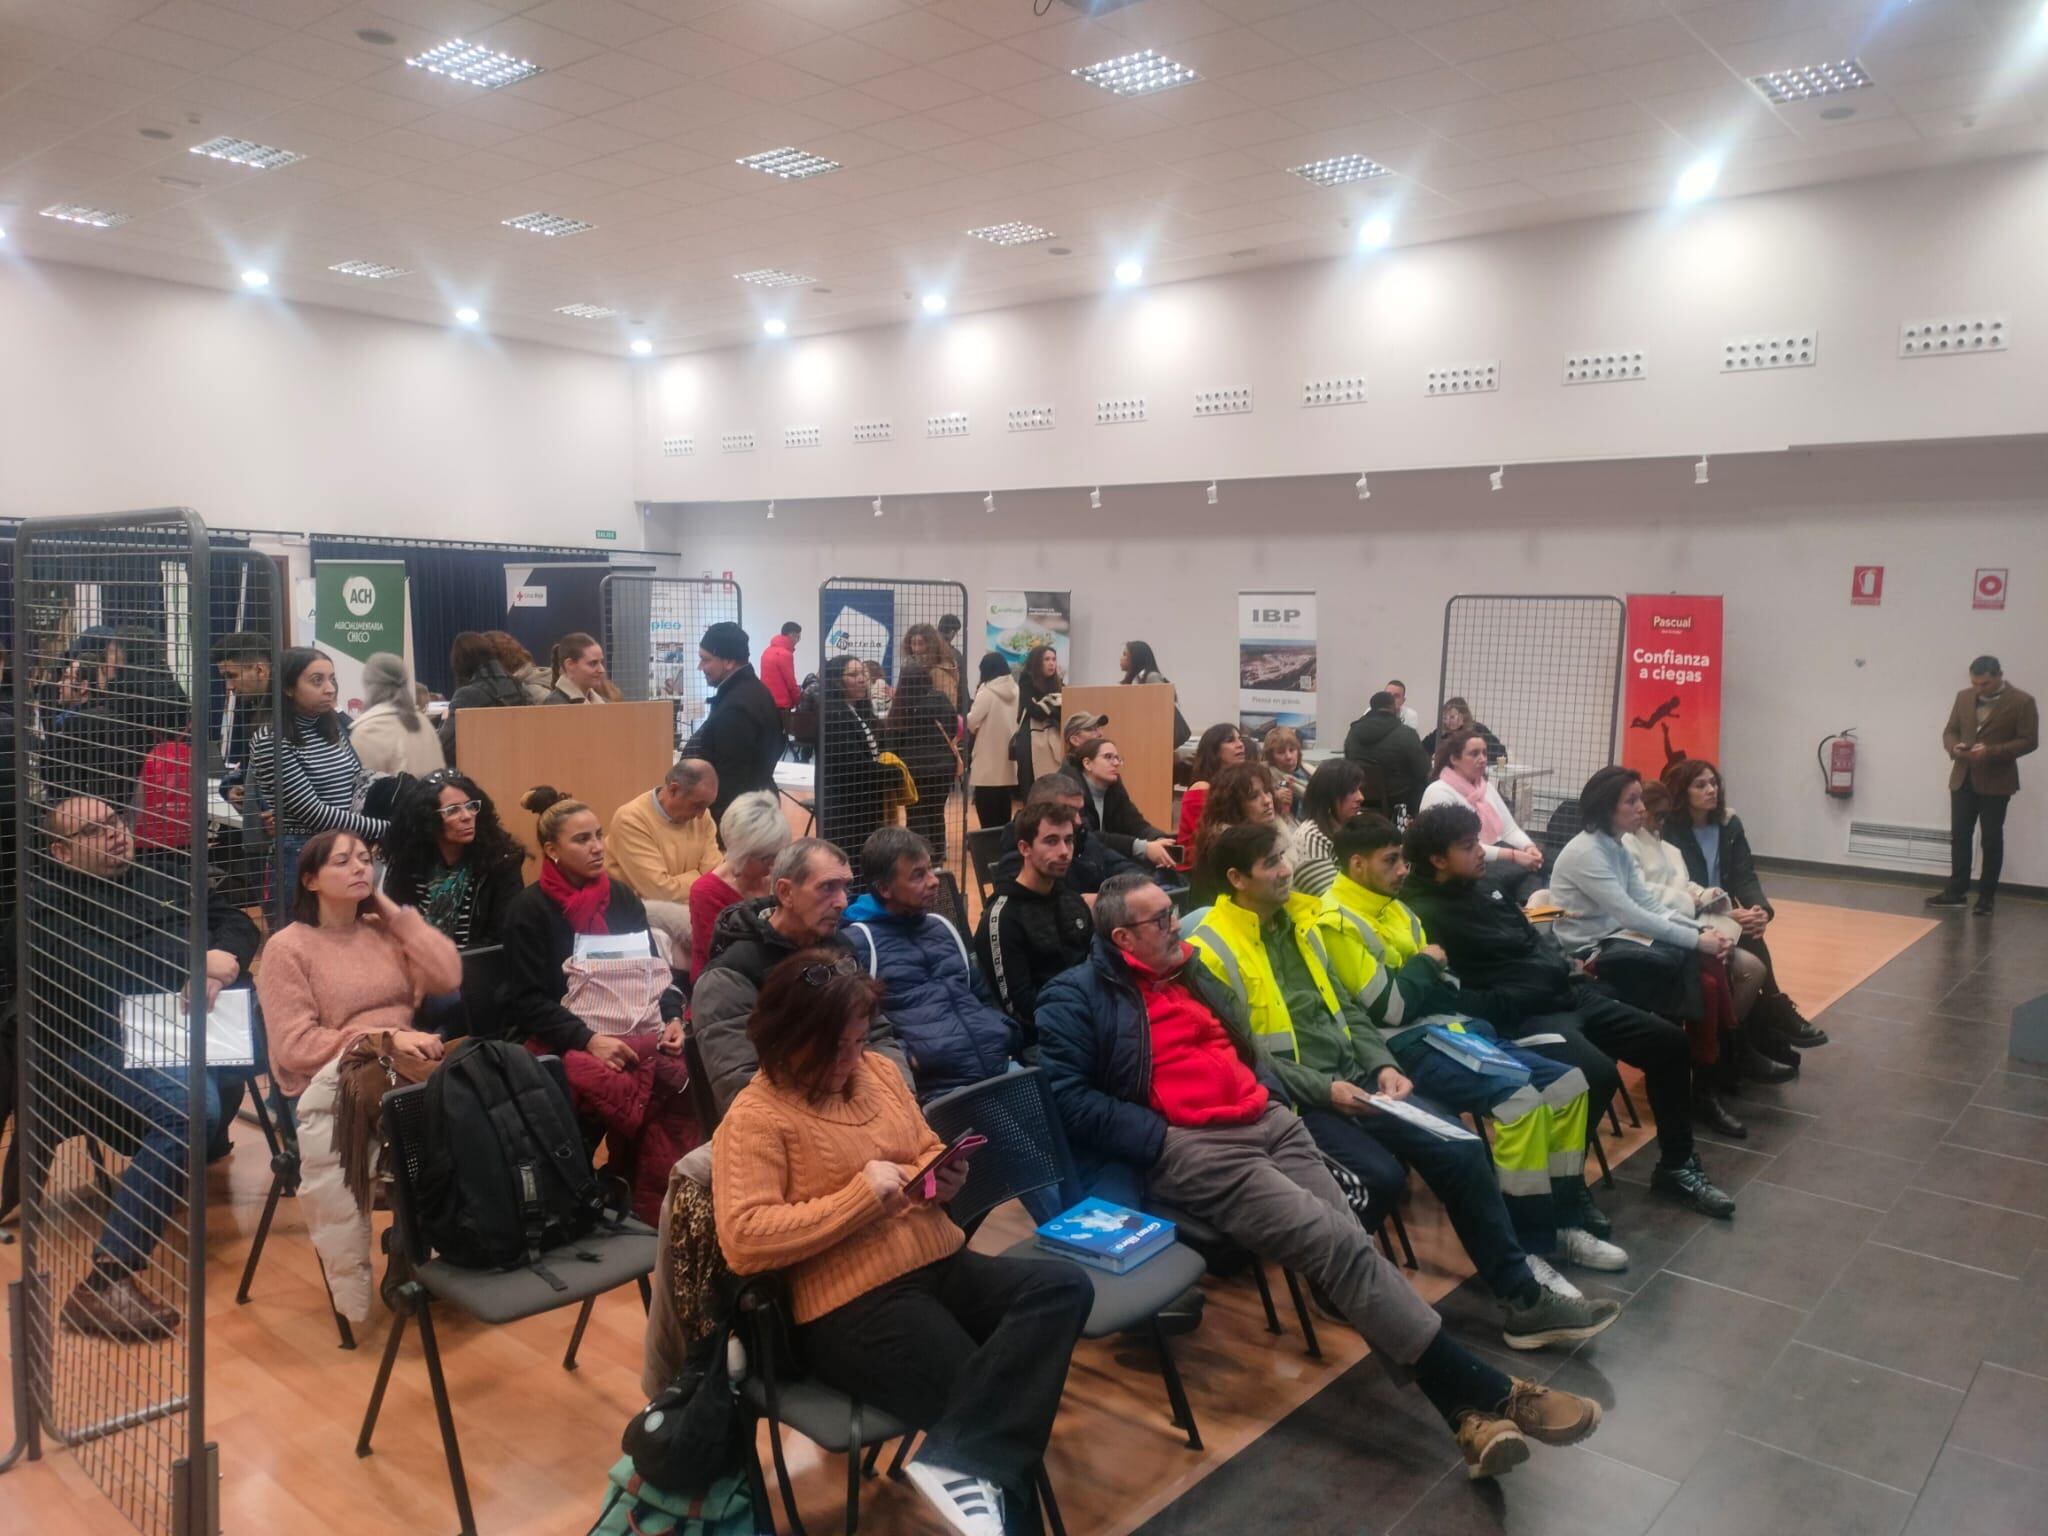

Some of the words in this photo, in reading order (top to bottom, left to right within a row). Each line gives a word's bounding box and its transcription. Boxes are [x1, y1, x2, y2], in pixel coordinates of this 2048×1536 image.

[350, 588, 372, 604] ACH
[1252, 609, 1301, 623] IBP
[1653, 615, 1692, 628] Pascual
[347, 631, 370, 643] CHICO
[1633, 648, 1710, 667] Confianza
[1639, 667, 1649, 680] a
[1652, 666, 1702, 685] ciegas
